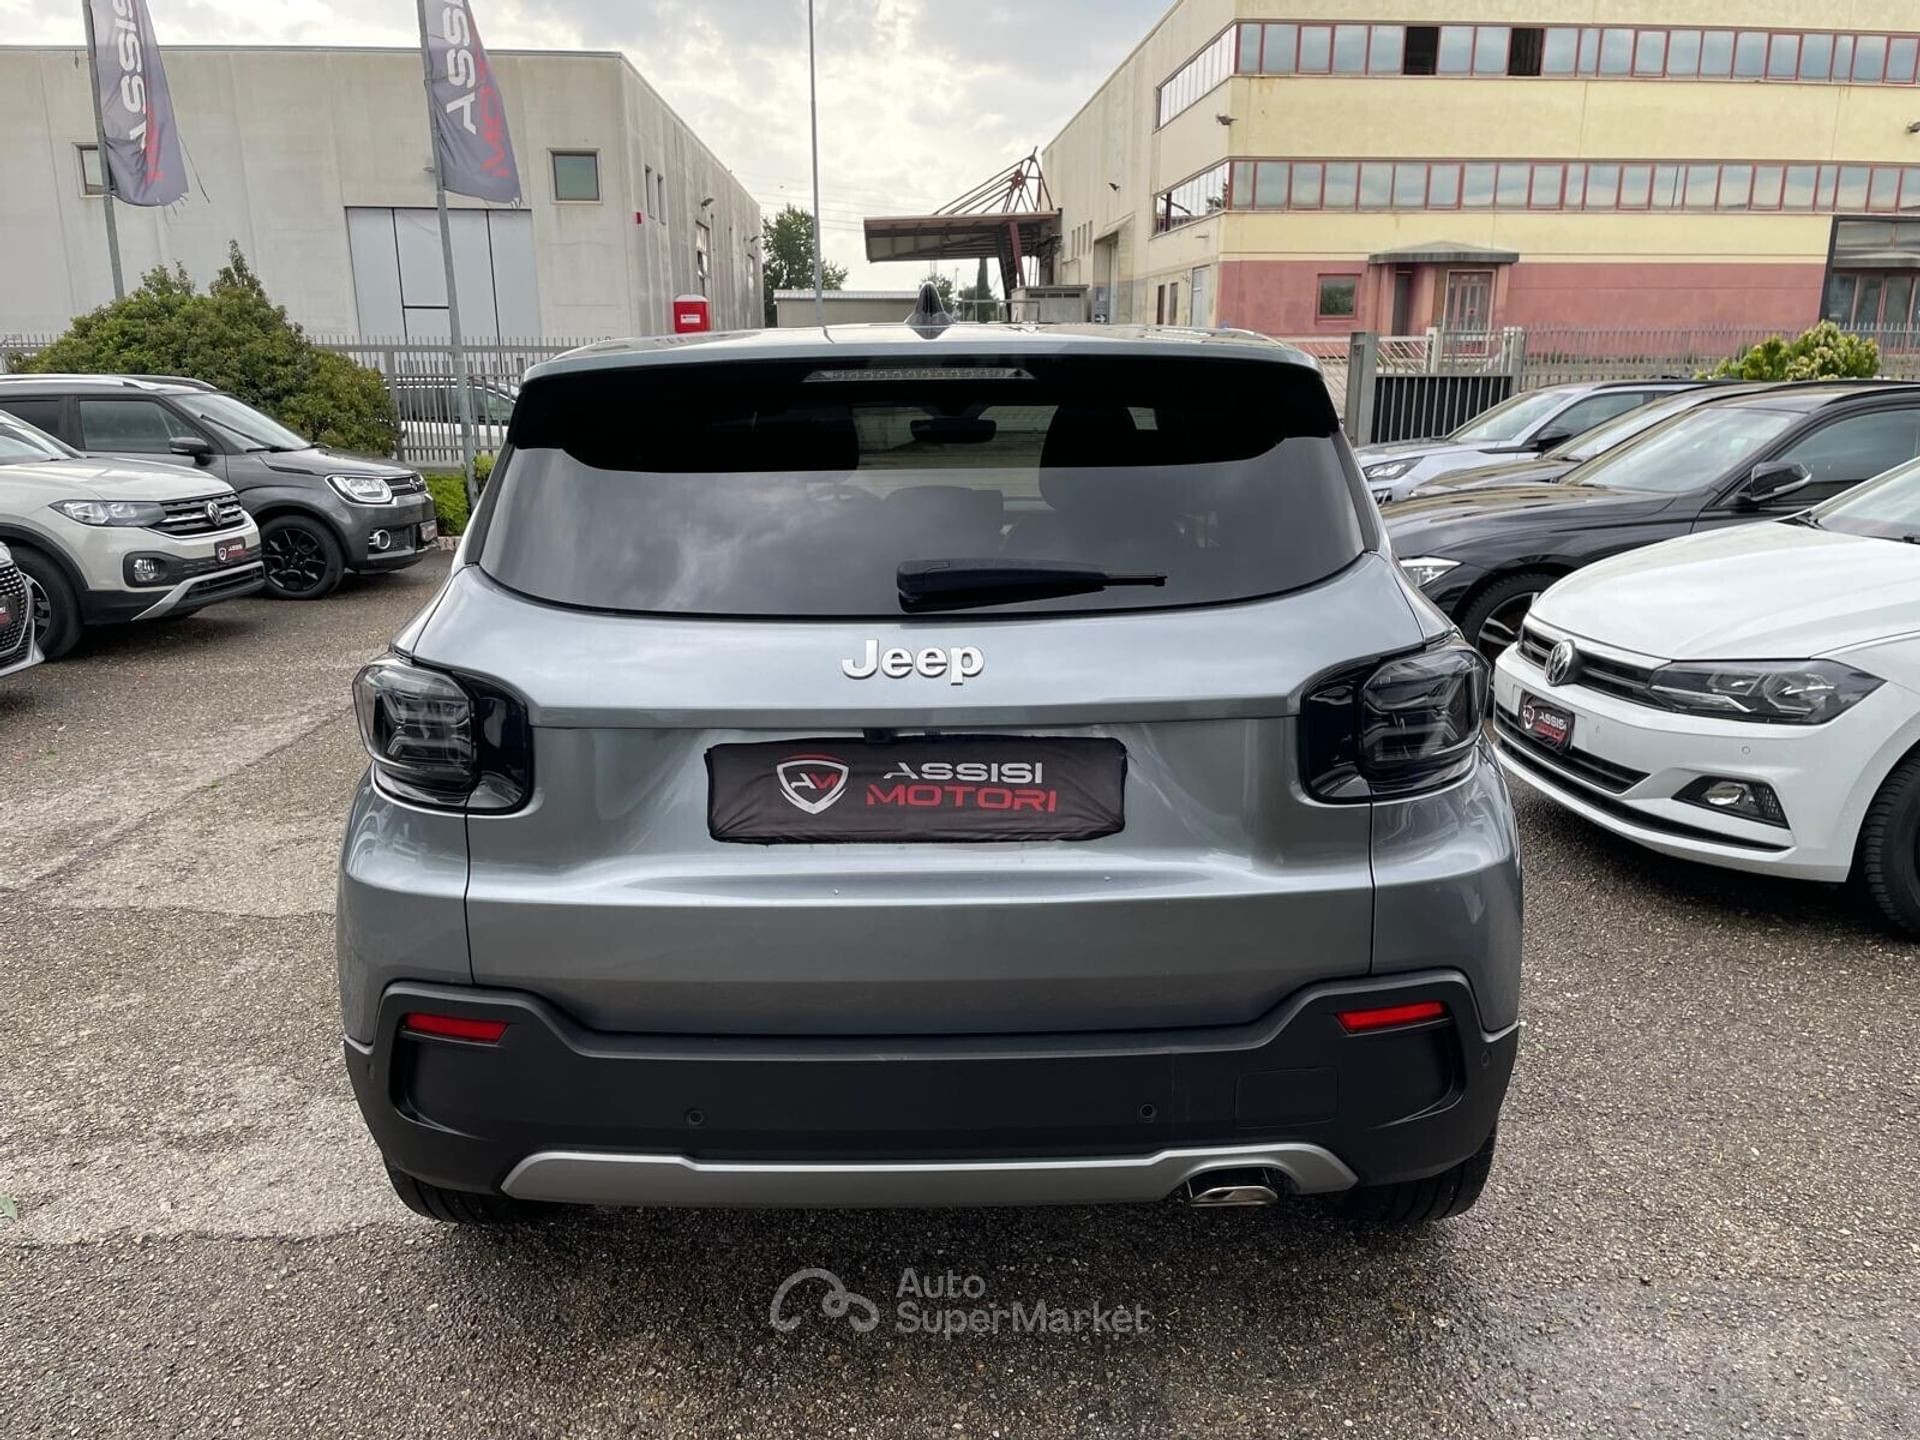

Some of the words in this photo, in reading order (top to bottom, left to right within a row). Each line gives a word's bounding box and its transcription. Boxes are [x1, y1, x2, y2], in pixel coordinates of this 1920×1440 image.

[442, 0, 477, 135] ASS
[842, 639, 985, 686] Jeep
[883, 762, 1043, 784] ASSISI
[866, 784, 1057, 813] MOTORI
